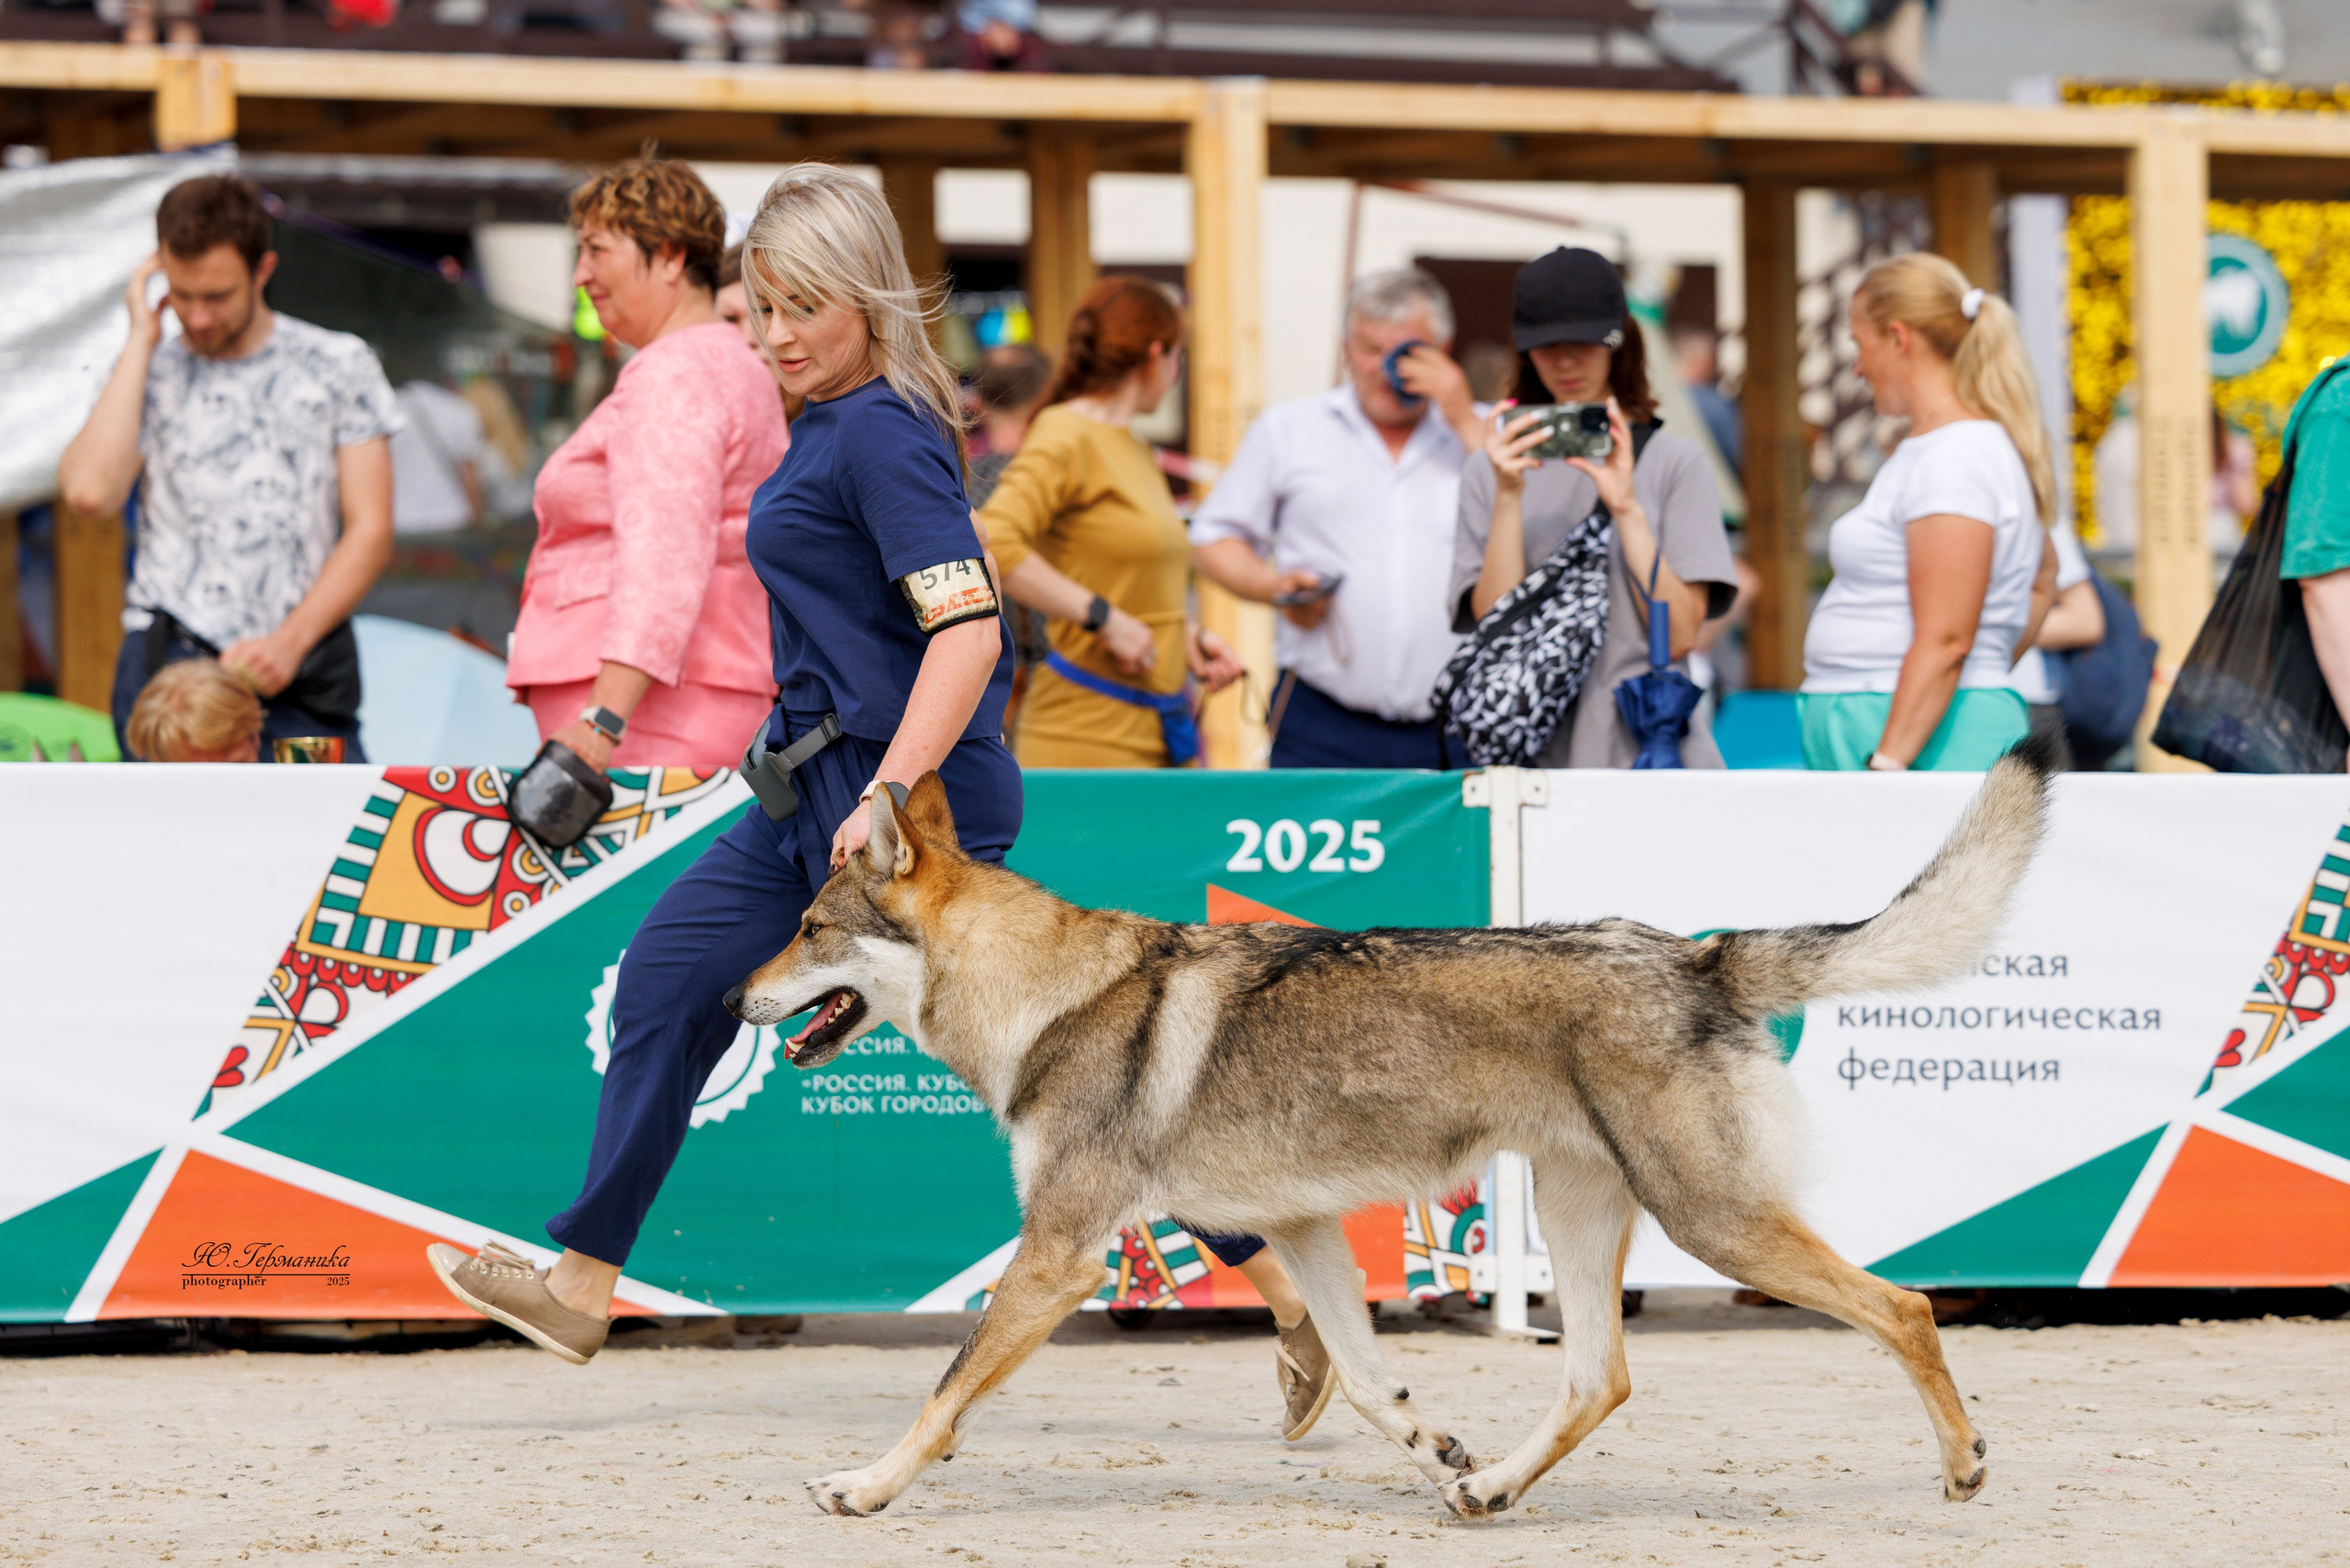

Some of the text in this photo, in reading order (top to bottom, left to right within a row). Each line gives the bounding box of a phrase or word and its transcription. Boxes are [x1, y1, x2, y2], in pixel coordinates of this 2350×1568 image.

[1225, 818, 1385, 873] 2025
[1838, 1006, 2162, 1030] кинологическая
[1838, 1047, 2060, 1091] федерация
[801, 1096, 875, 1114] КУБОК
